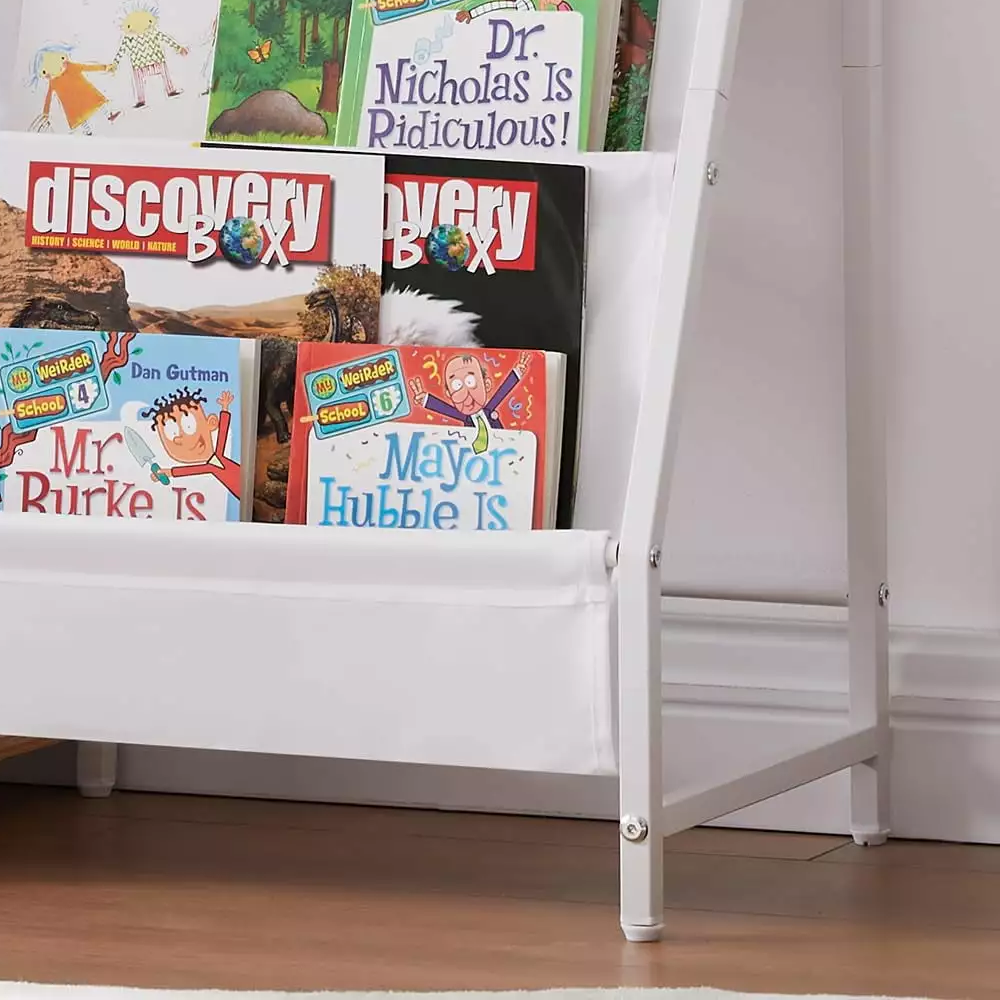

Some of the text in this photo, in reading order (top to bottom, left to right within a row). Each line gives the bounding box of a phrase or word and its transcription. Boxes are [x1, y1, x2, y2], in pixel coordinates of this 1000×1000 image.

[486, 18, 545, 61] Dr.
[373, 57, 573, 106] Nicholas Is
[367, 107, 570, 149] Ridiculous!
[30, 166, 324, 253] discovery
[31, 235, 177, 252] HISTORY SCIENCE WORLD NATURE
[131, 361, 229, 382] Dan Gutman
[78, 383, 90, 404] 4
[379, 391, 393, 412] 6
[50, 426, 123, 479] Mr.
[378, 431, 517, 493] Mayor
[319, 476, 509, 530] Hubble Is
